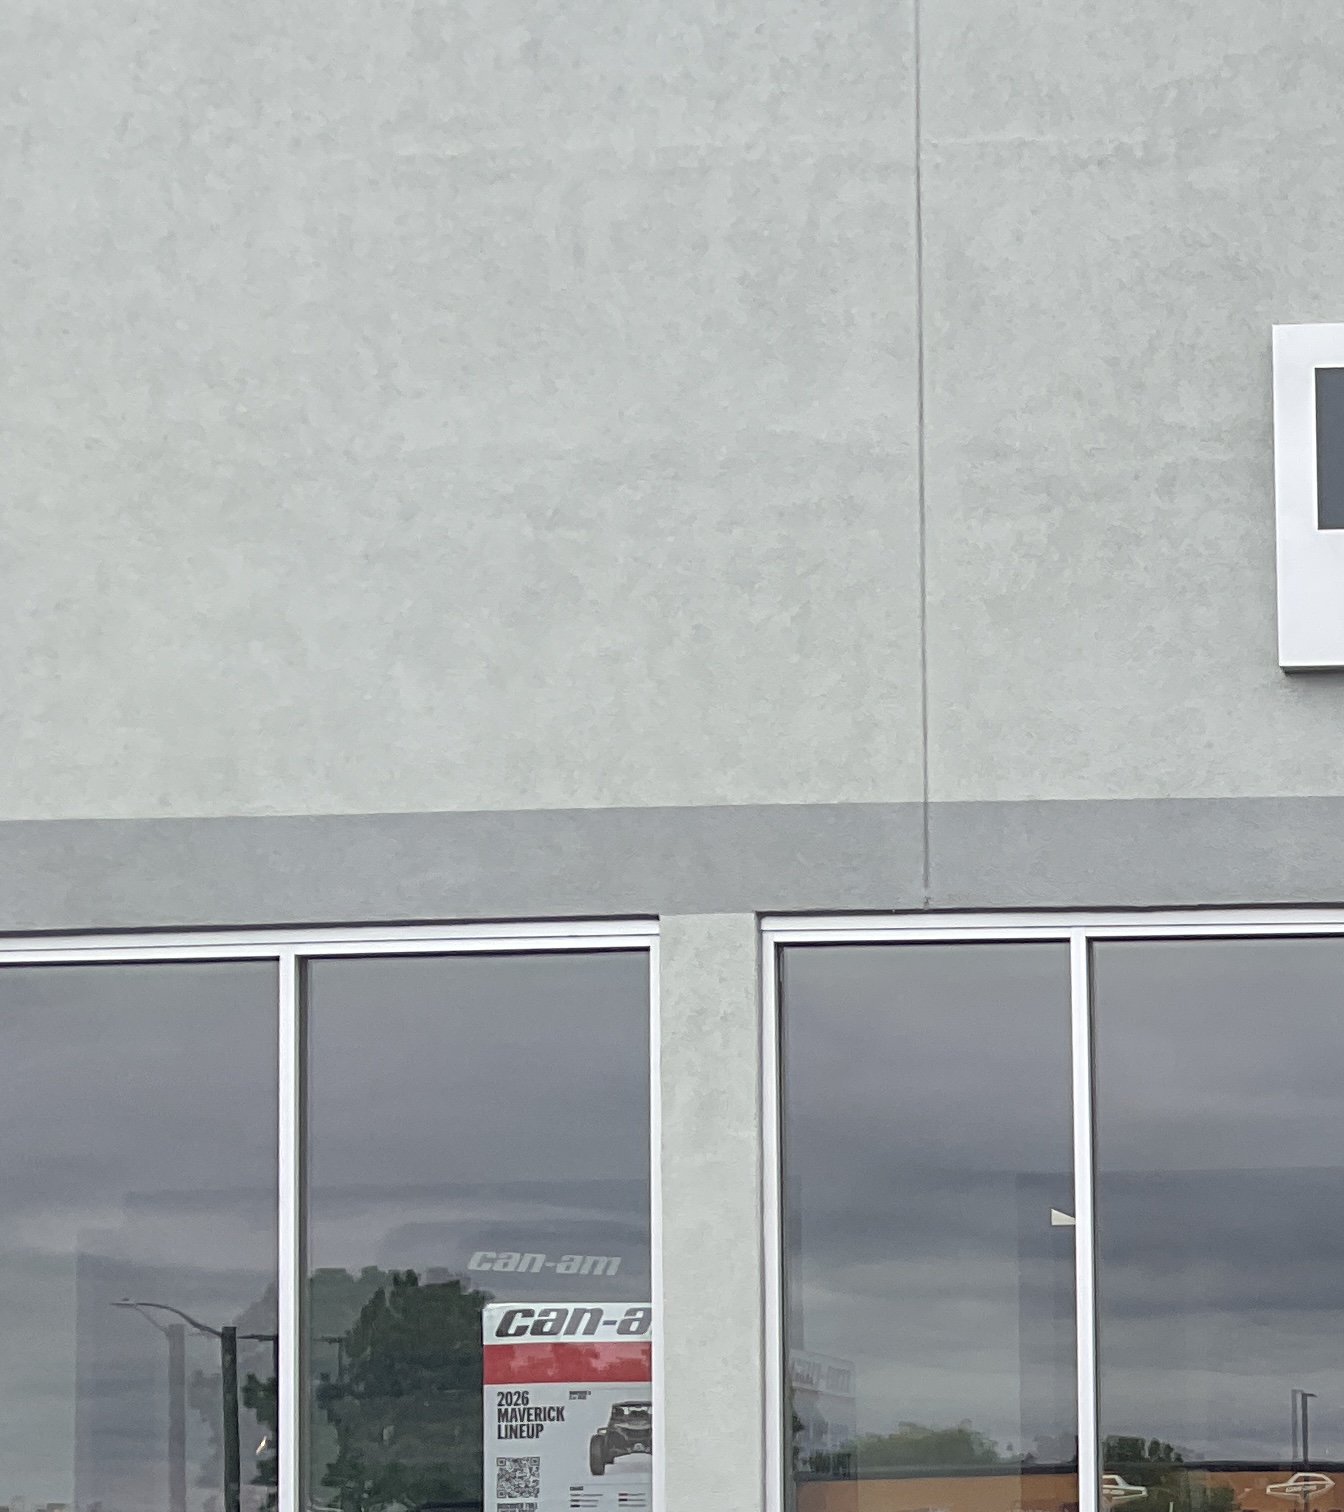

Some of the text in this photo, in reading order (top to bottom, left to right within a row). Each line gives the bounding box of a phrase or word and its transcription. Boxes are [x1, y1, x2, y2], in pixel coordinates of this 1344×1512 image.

[468, 1251, 622, 1276] can-am
[495, 1307, 651, 1337] can-a
[497, 1390, 530, 1406] 2026
[497, 1406, 565, 1423] MAVERICK
[497, 1423, 544, 1439] LINEUP
